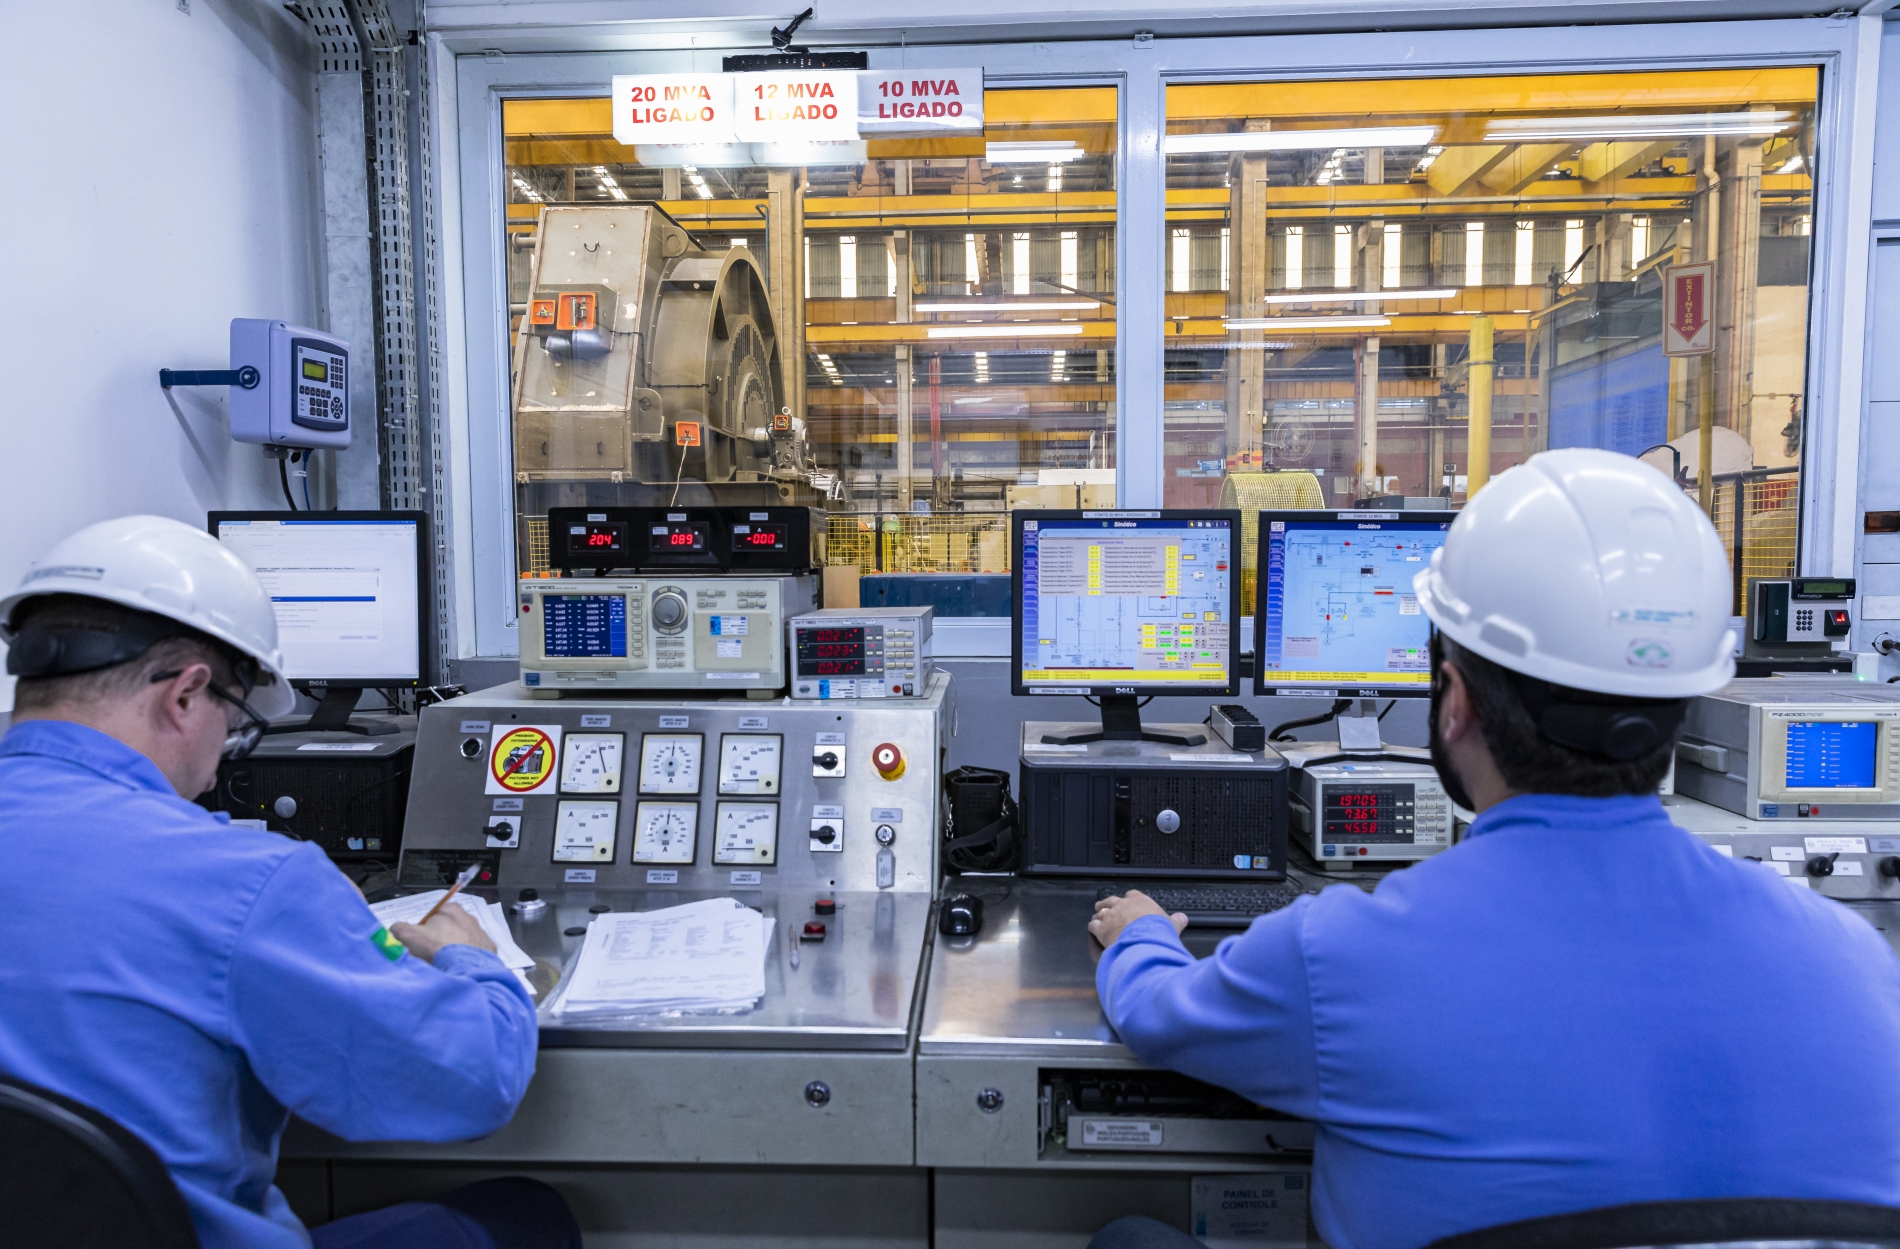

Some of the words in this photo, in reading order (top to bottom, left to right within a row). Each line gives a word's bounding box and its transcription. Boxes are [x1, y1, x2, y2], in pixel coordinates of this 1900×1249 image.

[632, 86, 656, 103] 20
[664, 85, 712, 102] MVA
[754, 83, 778, 100] 12
[786, 82, 835, 99] MVA
[878, 80, 904, 97] 10
[911, 79, 960, 96] MVA
[632, 106, 715, 124] LIGADO
[754, 104, 838, 122] LIGADO
[878, 101, 963, 119] LIGADO
[1685, 278, 1693, 324] EXTINTOR
[589, 534, 612, 546] 204
[671, 534, 693, 545] 089
[1224, 1190, 1261, 1198] PAINEL
[1262, 1190, 1276, 1198] DE
[1222, 1200, 1277, 1210] CONTROLE
